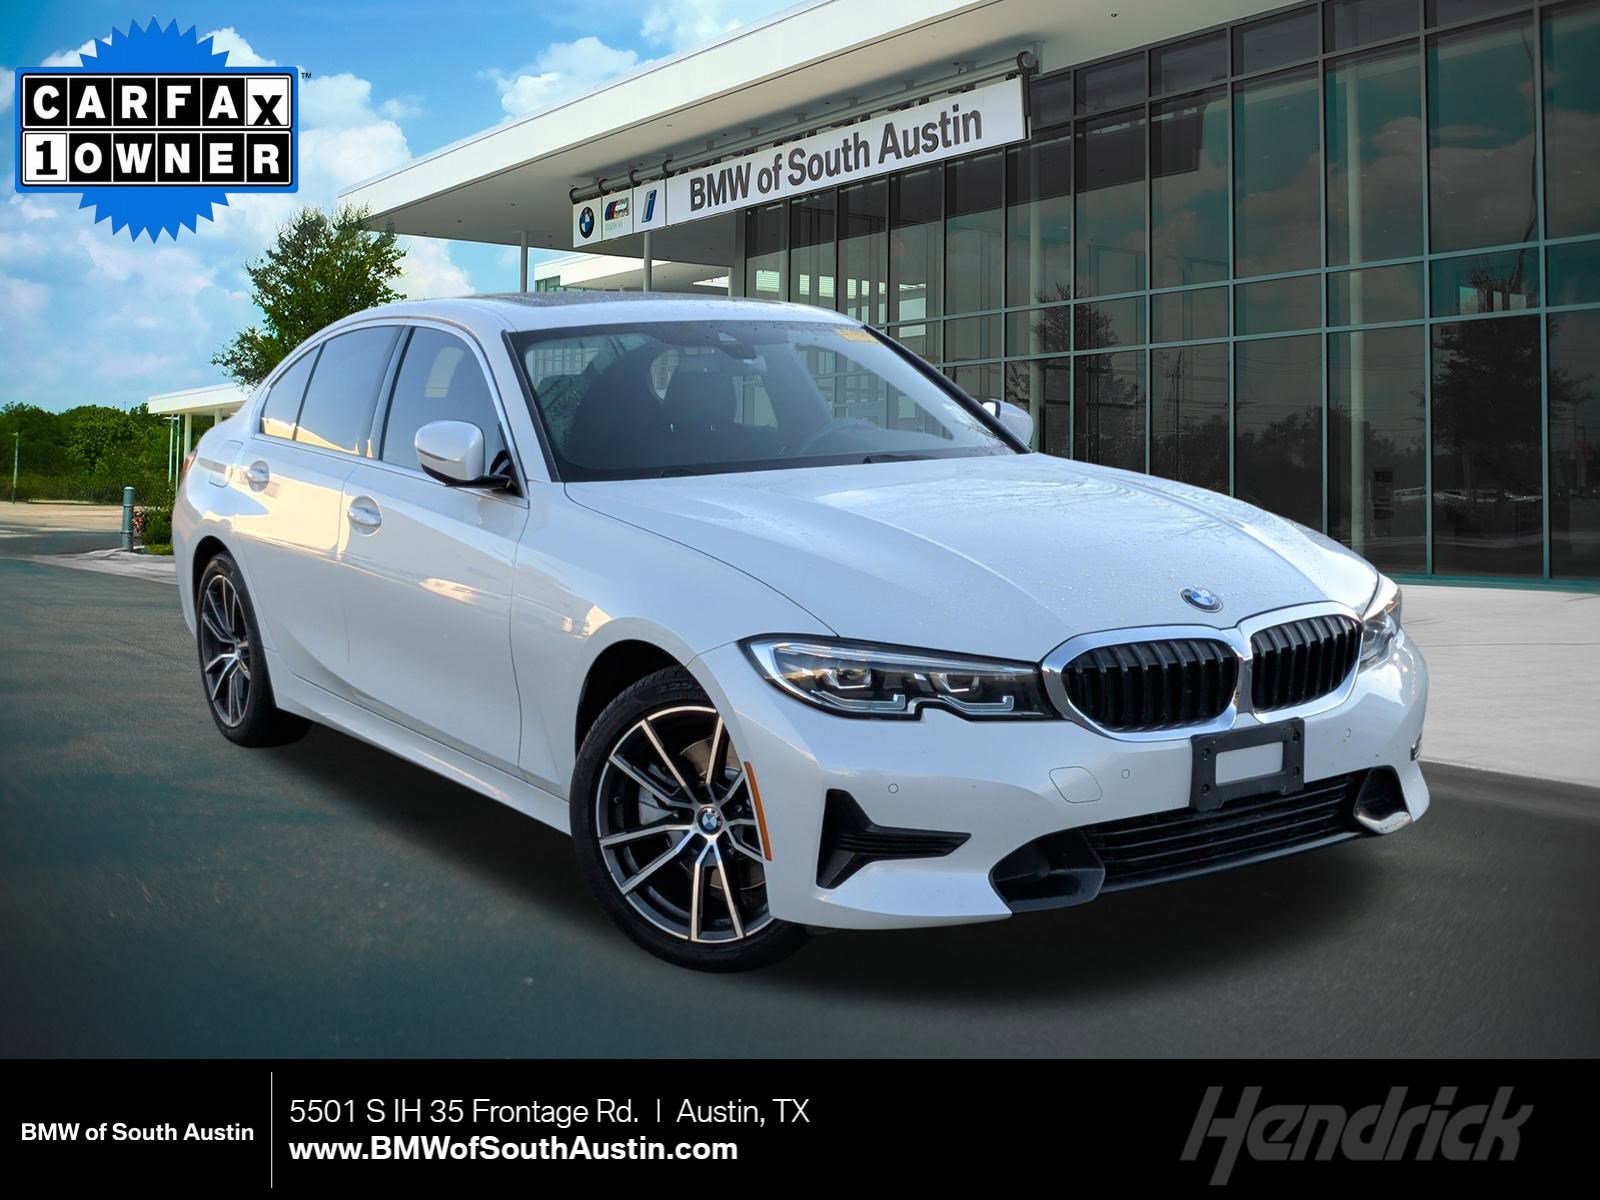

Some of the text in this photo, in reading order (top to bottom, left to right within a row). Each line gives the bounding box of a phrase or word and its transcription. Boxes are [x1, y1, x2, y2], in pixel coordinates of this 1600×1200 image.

[690, 104, 982, 211] BMW of South Austin
